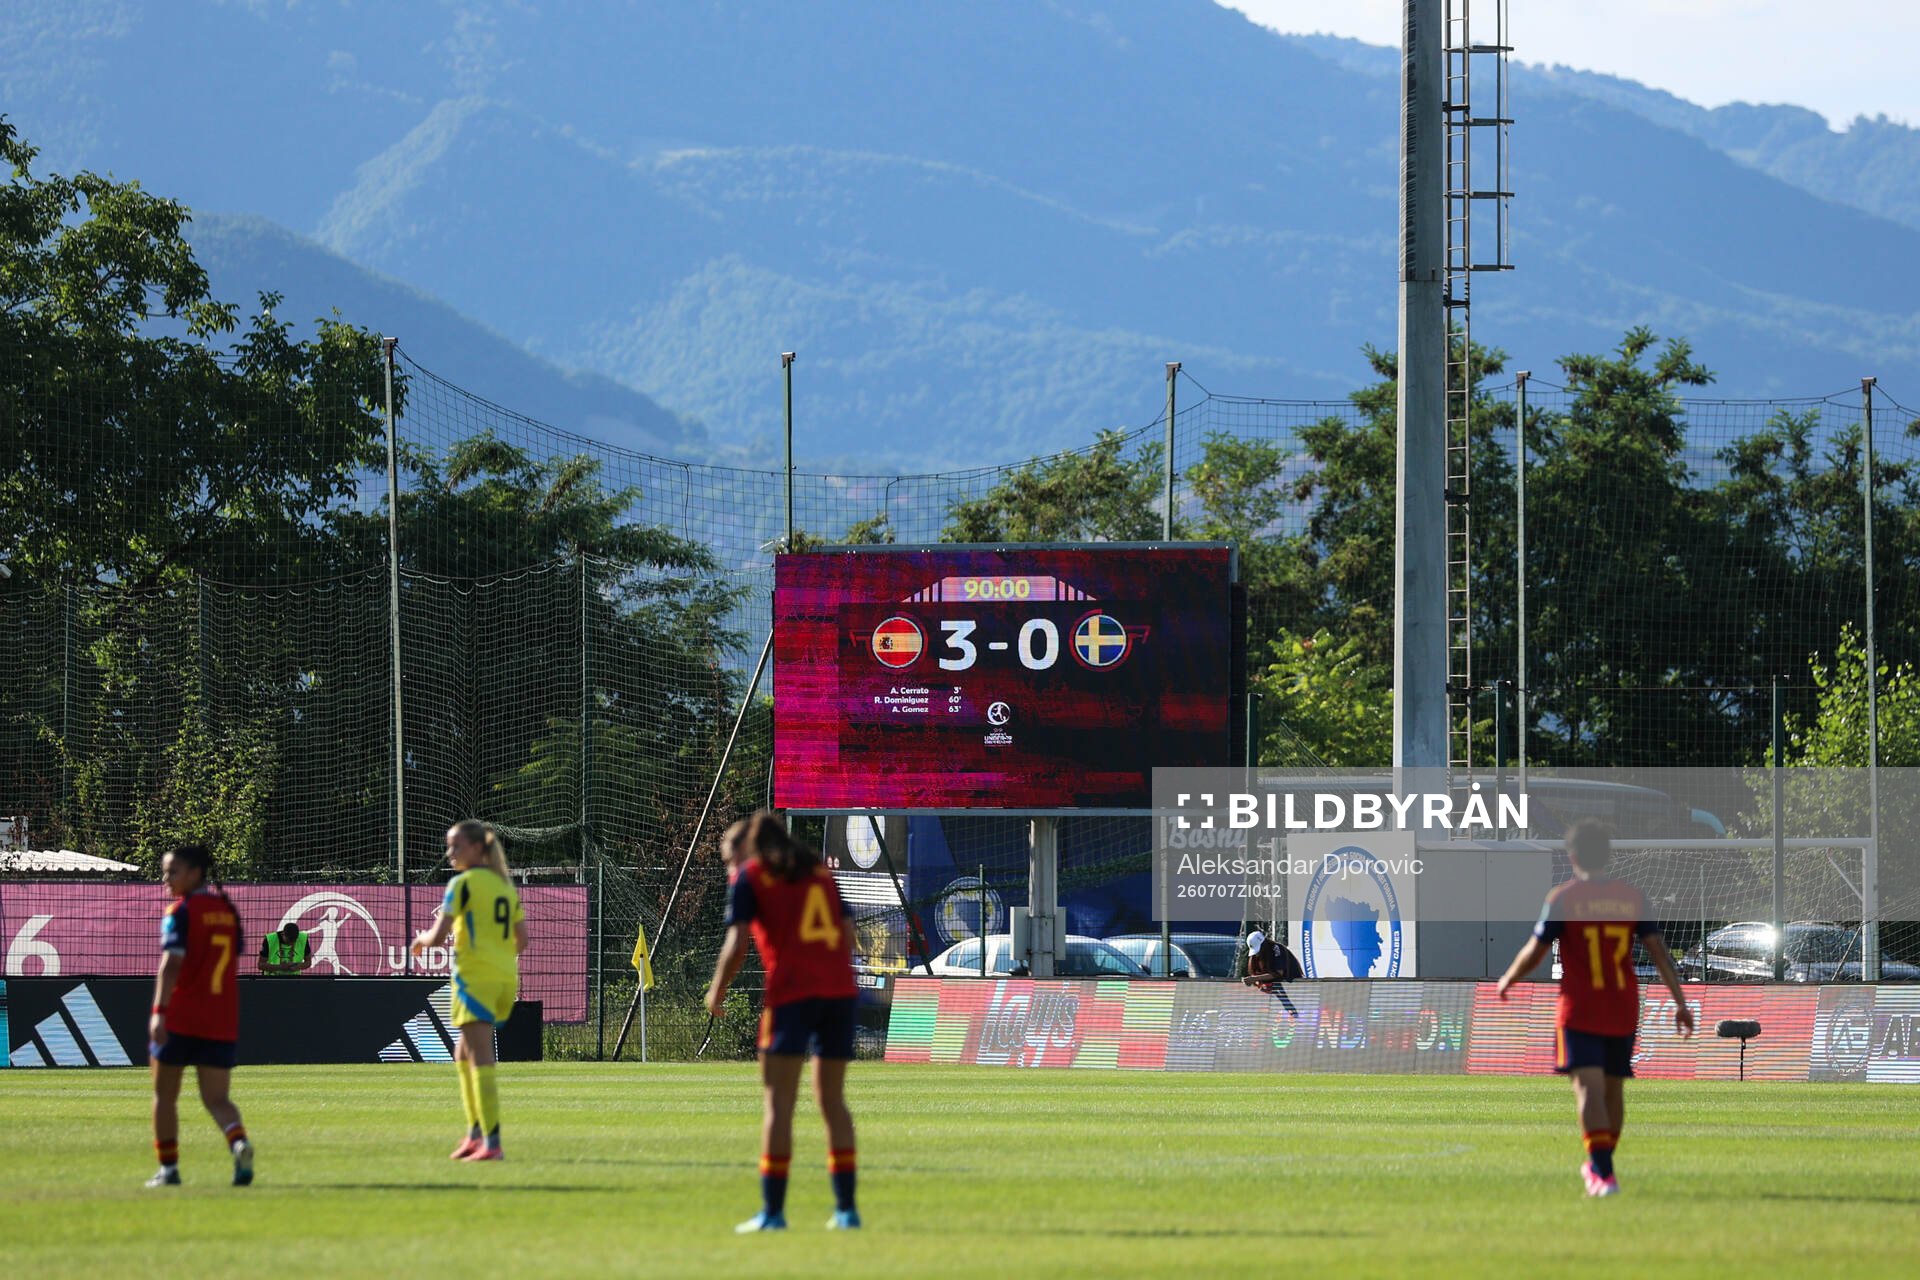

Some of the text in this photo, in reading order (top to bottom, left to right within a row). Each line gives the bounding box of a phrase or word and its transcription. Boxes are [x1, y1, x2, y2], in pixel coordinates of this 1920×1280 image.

[964, 579, 1031, 599] 90:00
[938, 620, 978, 671] 3
[1018, 618, 1060, 671] 0
[874, 696, 883, 704] R.
[948, 696, 962, 704] 60'
[953, 686, 962, 694] 3'
[6, 915, 61, 976] 6
[494, 896, 511, 940] 9
[799, 884, 841, 951] 4
[211, 934, 232, 995] 7
[1583, 924, 1630, 990] 17
[976, 979, 1080, 1067] Lay's
